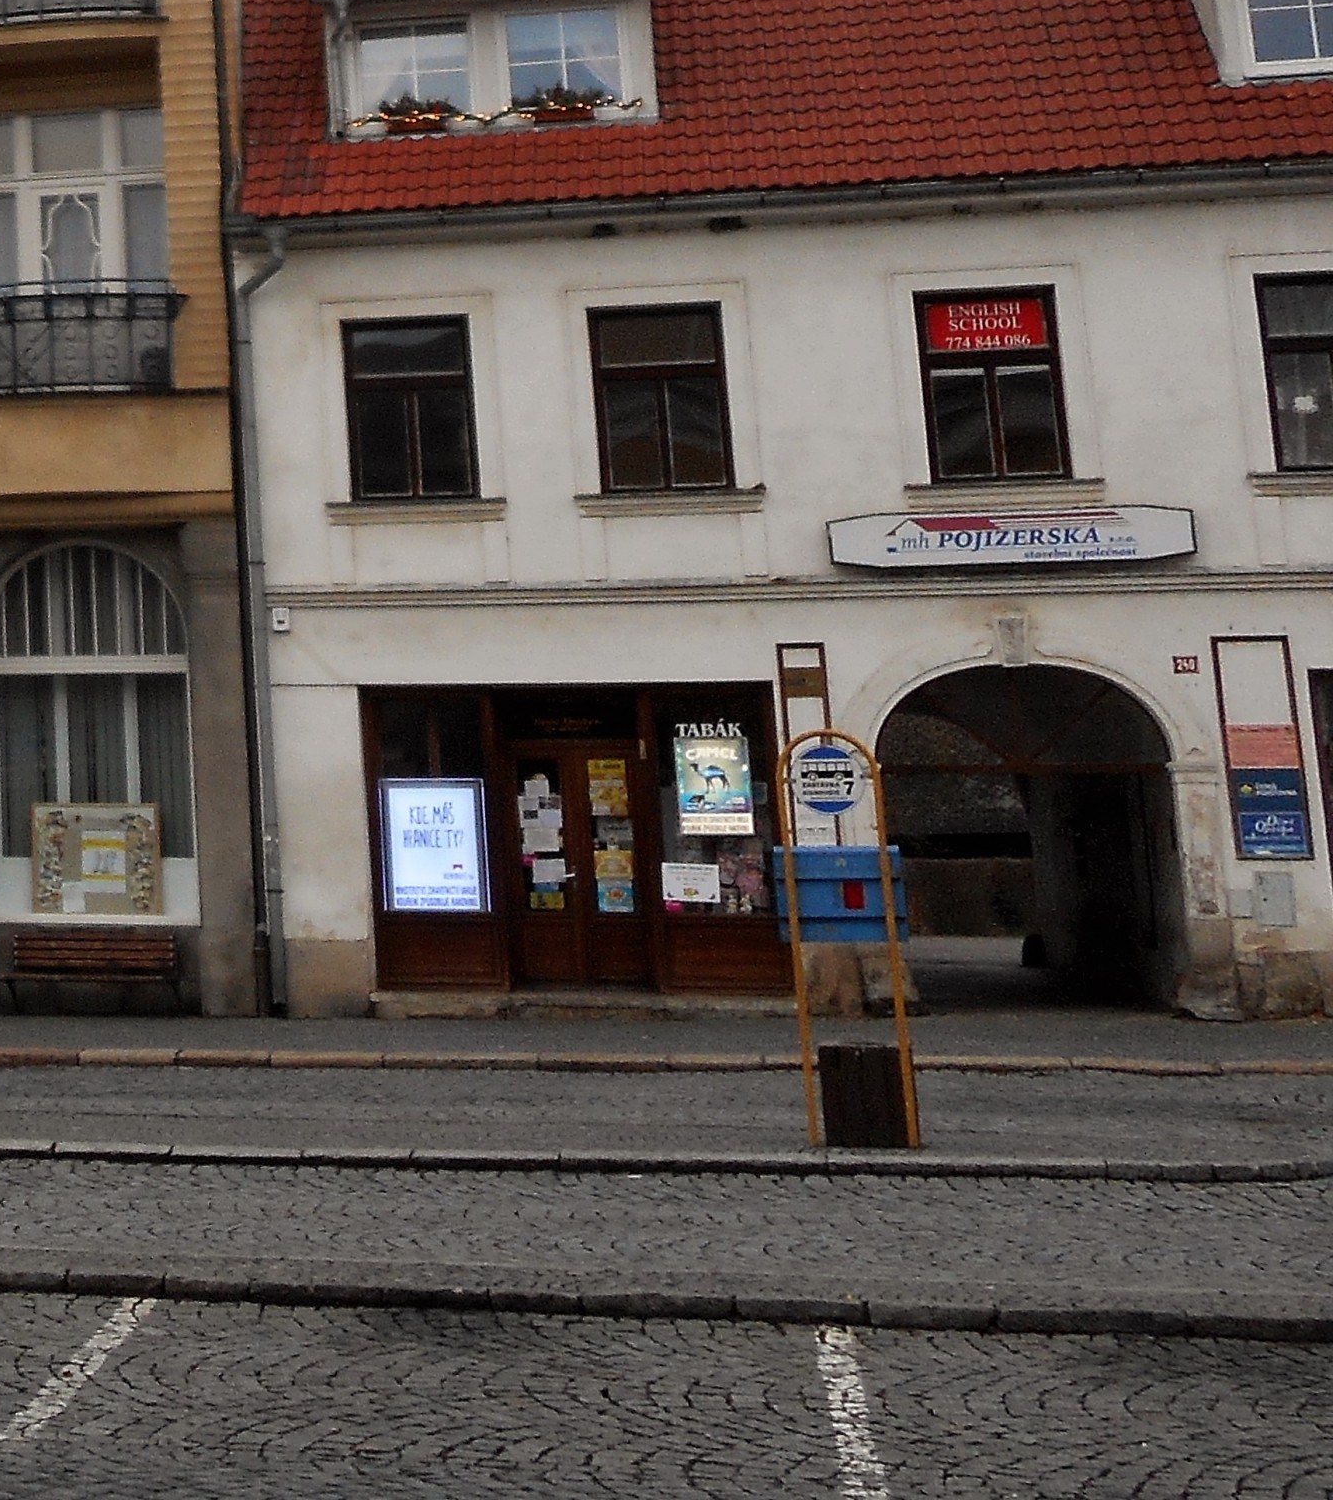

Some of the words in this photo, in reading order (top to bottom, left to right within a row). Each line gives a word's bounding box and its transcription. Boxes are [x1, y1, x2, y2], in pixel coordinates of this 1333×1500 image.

[948, 302, 1021, 318] ENGLISH
[948, 316, 1022, 331] SCHOOL
[945, 336, 971, 350] 774
[975, 335, 1001, 349] 844
[1004, 334, 1032, 347] 086
[901, 530, 930, 549] mh
[937, 521, 1101, 551] POJIZERSKÁ
[675, 718, 743, 738] TABÁK
[685, 746, 739, 761] CAMEL
[843, 781, 855, 796] 7
[409, 805, 429, 825] KDE
[432, 801, 455, 826] MÁŠ
